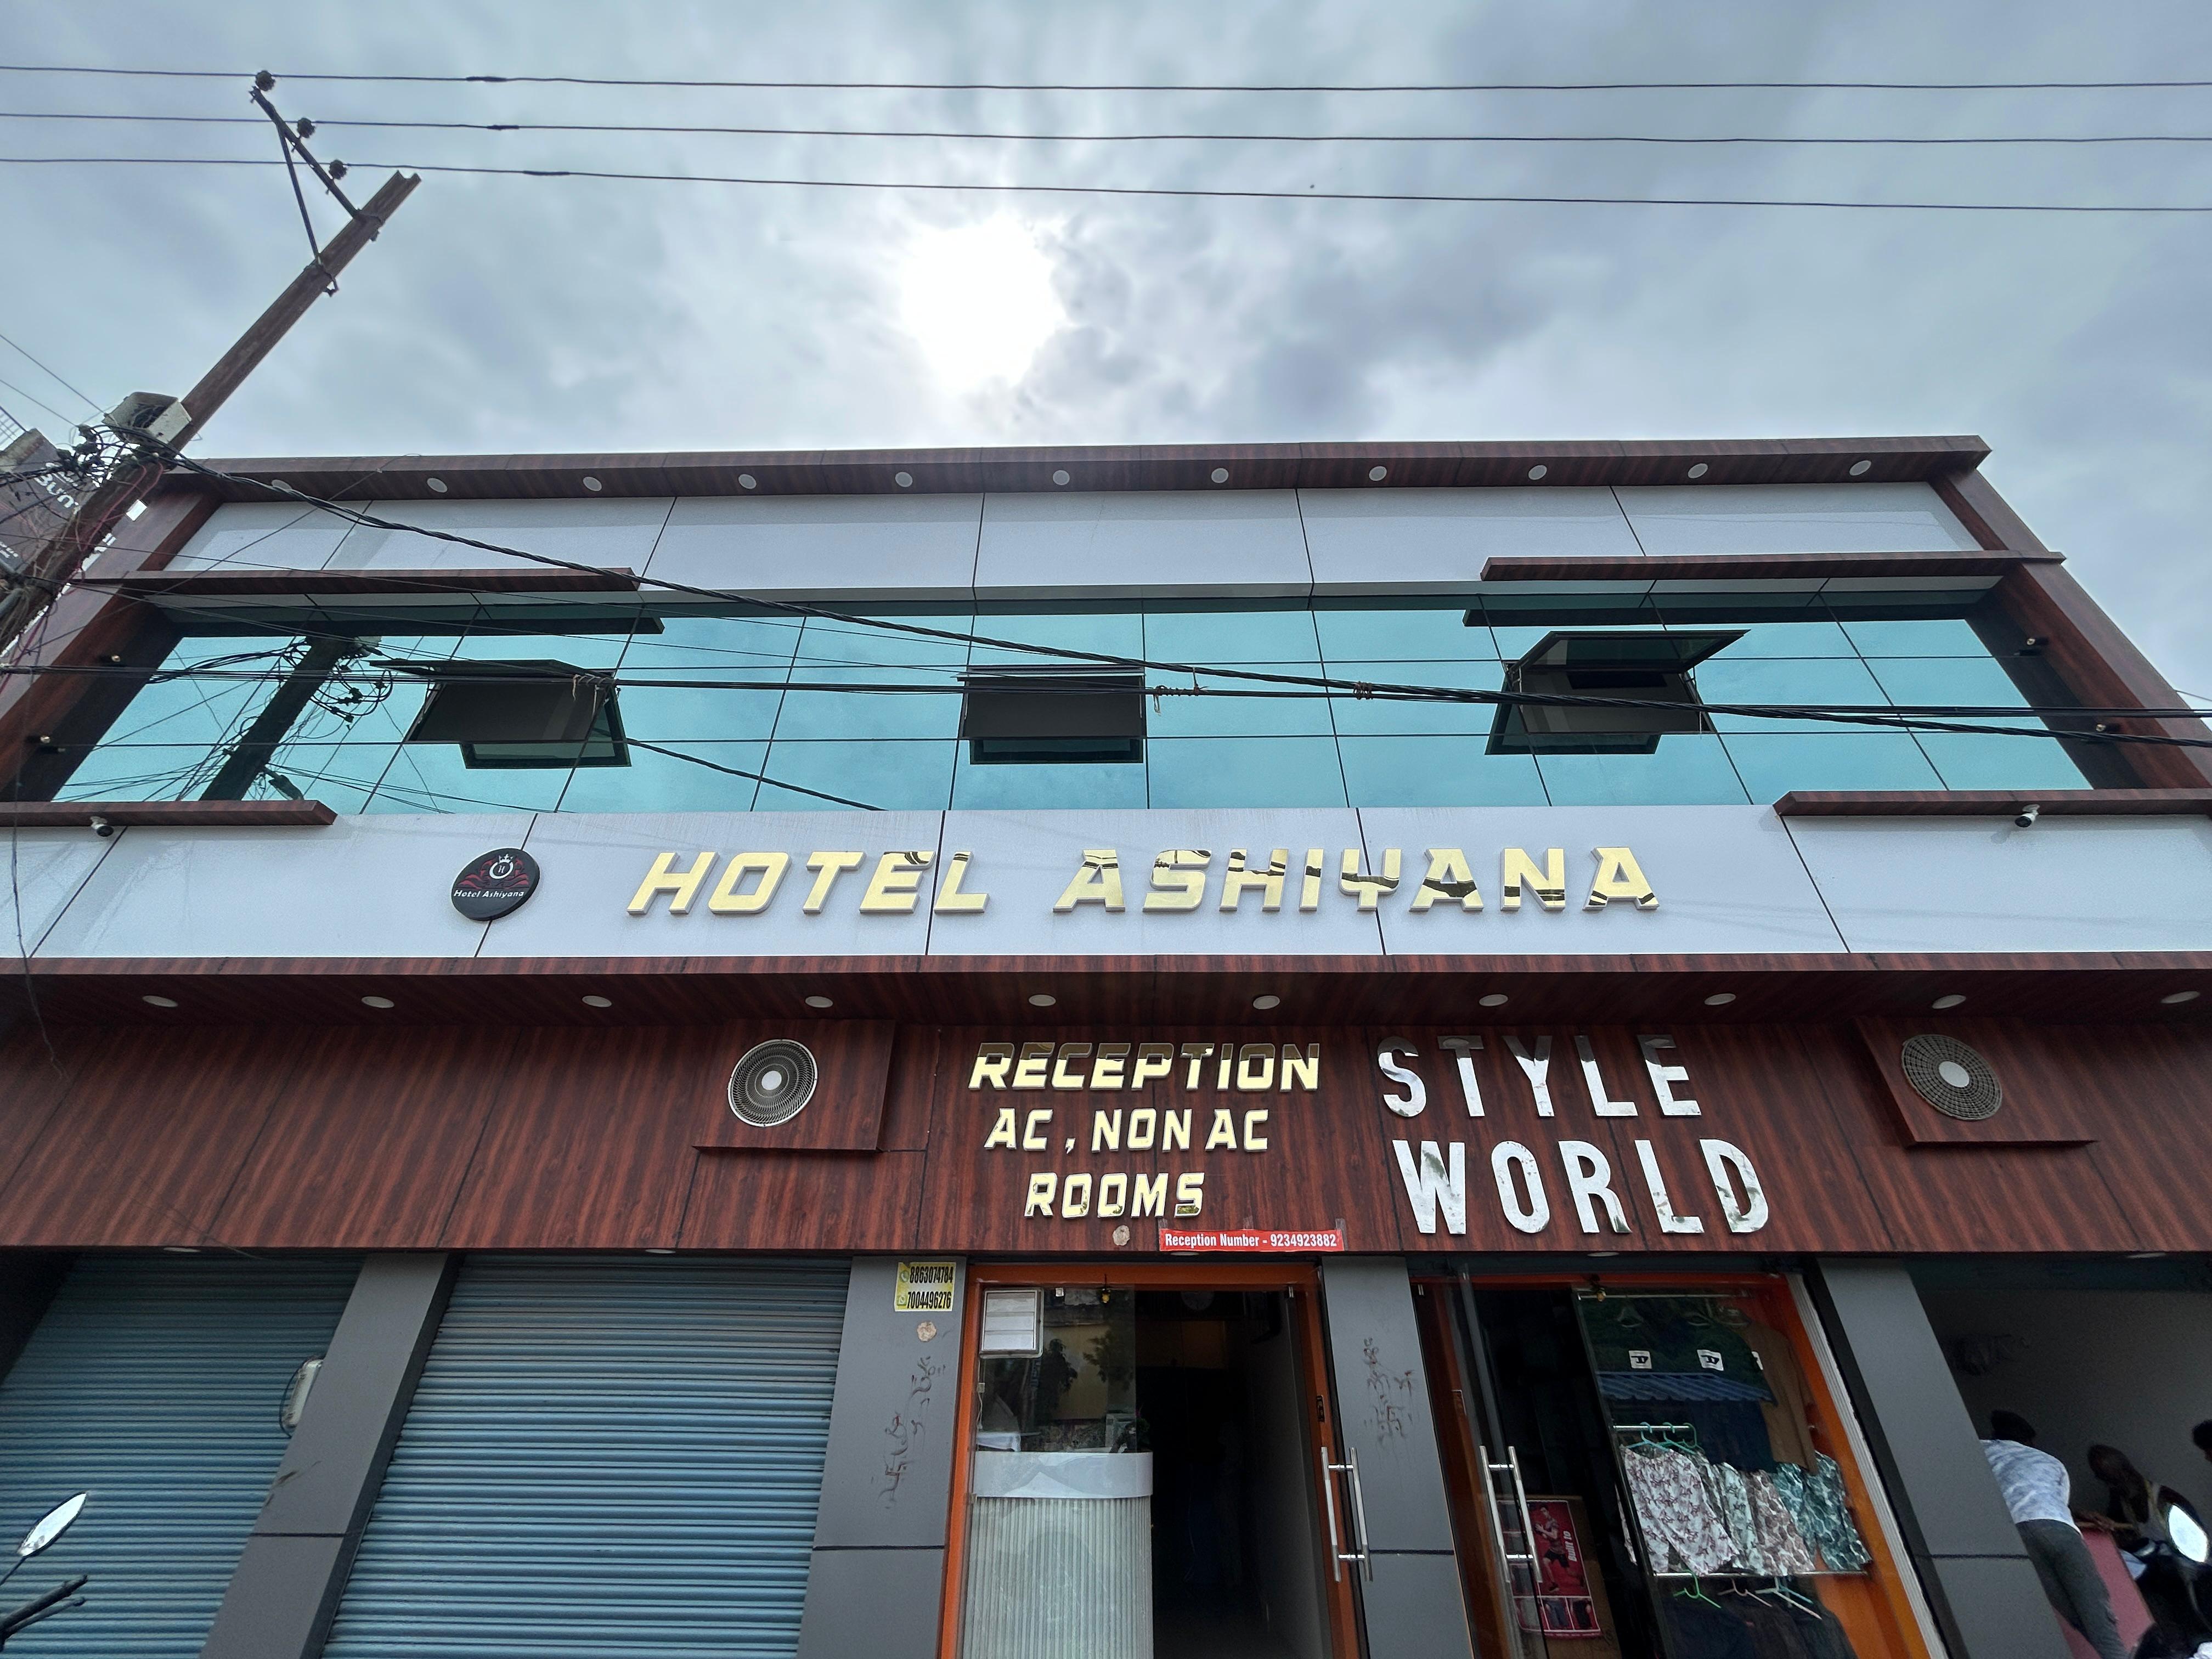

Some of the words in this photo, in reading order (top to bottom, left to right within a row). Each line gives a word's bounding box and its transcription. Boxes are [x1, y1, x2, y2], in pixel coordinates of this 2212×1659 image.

[482, 890, 524, 899] Ashiyana
[626, 851, 990, 915] HOTEL
[1052, 847, 1659, 912] ASHIYANA
[968, 1042, 1320, 1091] RECEPTION
[1377, 1034, 1702, 1118] STYLE
[984, 1108, 1053, 1151] AC
[1091, 1108, 1193, 1152] NON
[1205, 1109, 1268, 1152] AC
[1024, 1172, 1205, 1218] ROOMS
[1392, 1138, 1769, 1234] WORLD
[1165, 1233, 1217, 1249] Reception
[1220, 1233, 1260, 1247] Number
[1270, 1233, 1337, 1247] 9234923882
[910, 1266, 953, 1284] 8863074784
[907, 1291, 952, 1309] 7004496276
